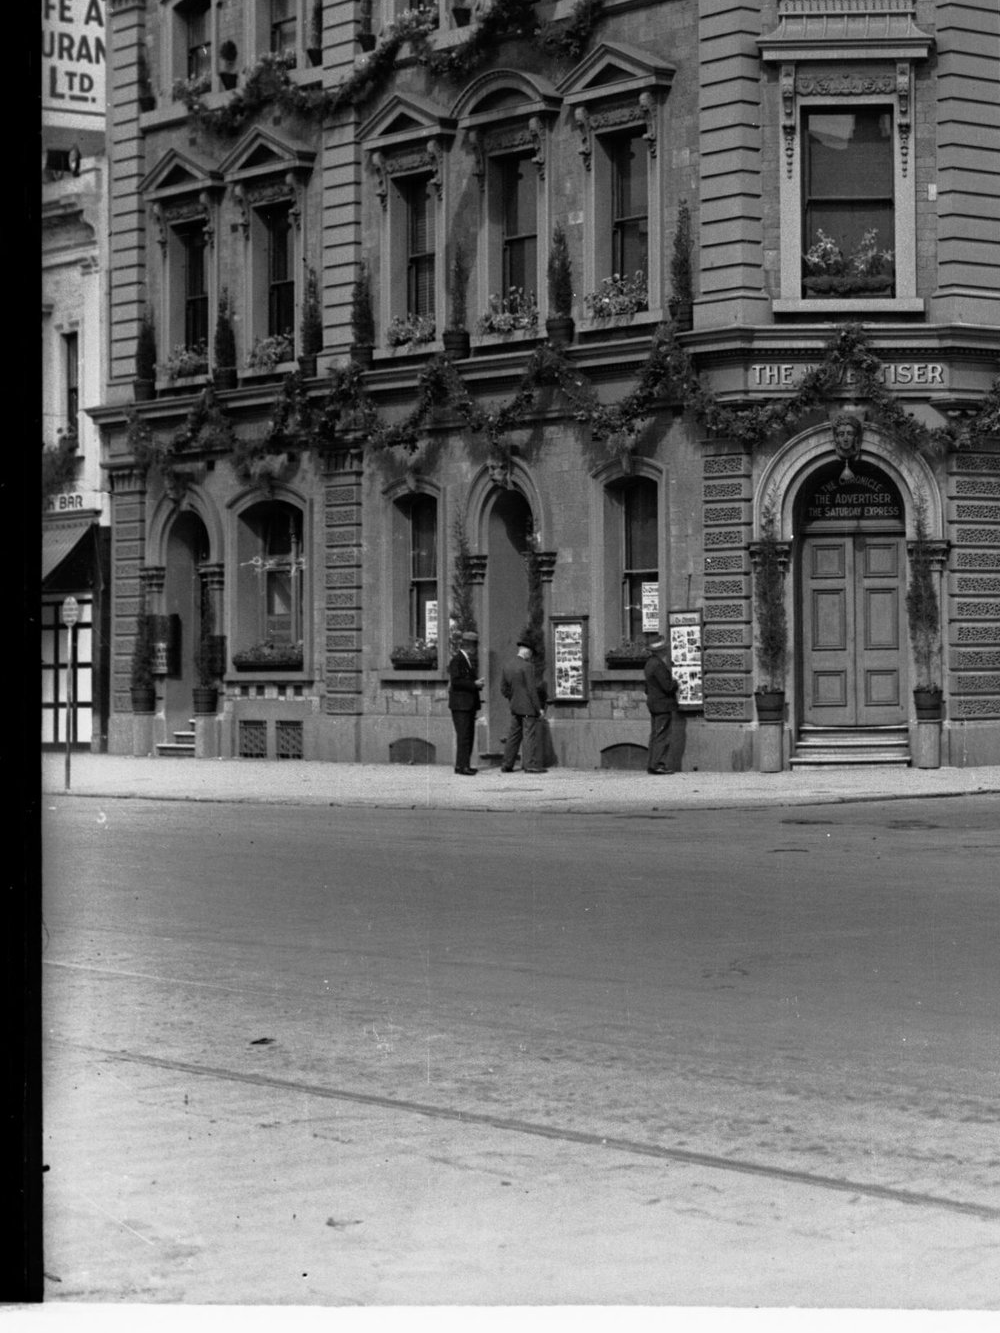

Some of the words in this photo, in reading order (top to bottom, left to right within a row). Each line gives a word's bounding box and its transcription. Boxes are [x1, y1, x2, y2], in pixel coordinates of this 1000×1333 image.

[752, 364, 794, 385] THE
[59, 495, 83, 509] BAR
[815, 494, 831, 504] THE
[835, 493, 891, 504] ADVERTISER
[825, 507, 861, 517] SATURDAY
[864, 507, 899, 516] EXPRESS
